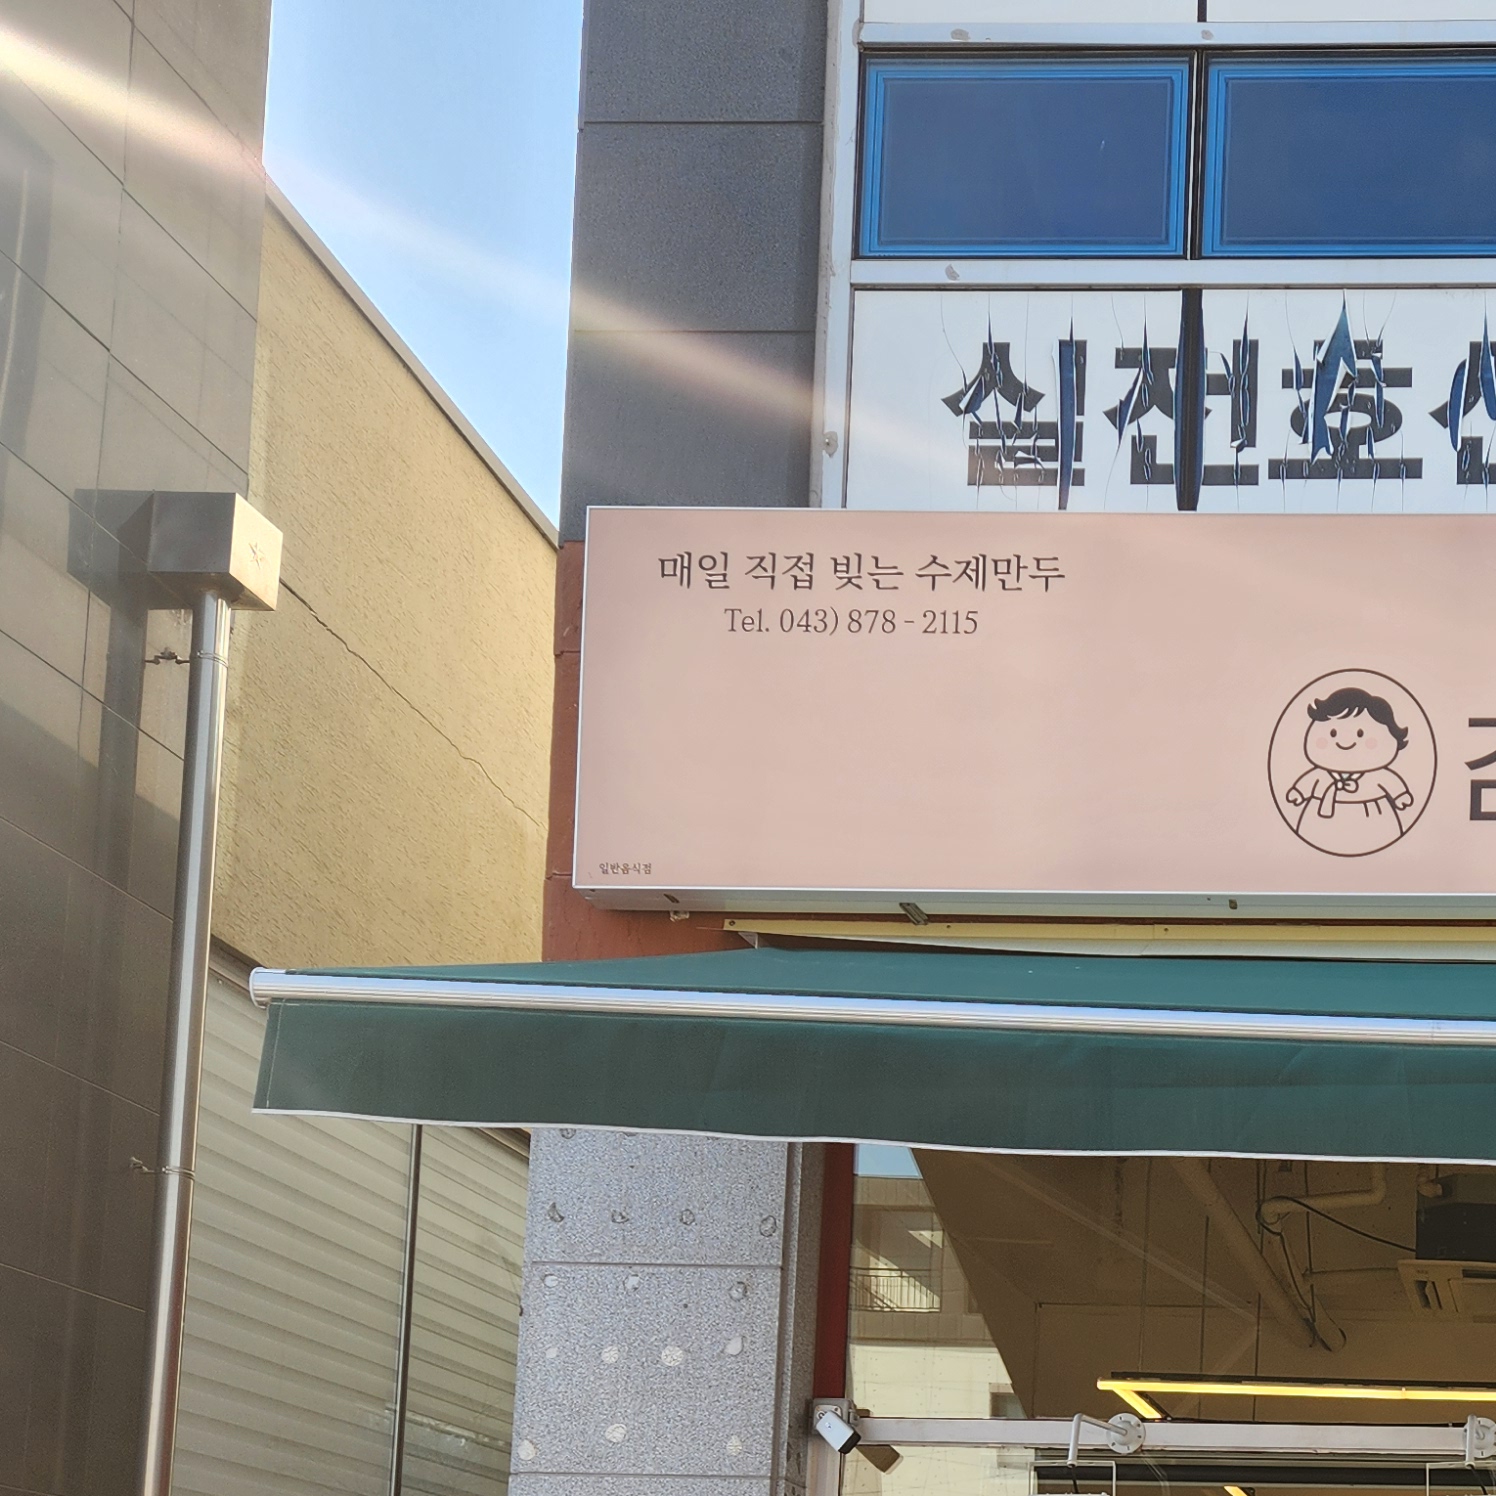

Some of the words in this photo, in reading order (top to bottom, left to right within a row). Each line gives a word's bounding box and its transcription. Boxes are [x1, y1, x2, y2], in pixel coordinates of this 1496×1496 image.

[658, 551, 731, 590] 매일
[744, 551, 816, 591] 직접
[831, 552, 904, 591] 빚는
[915, 553, 1066, 593] 수제만두
[724, 607, 770, 633] Tel.
[598, 861, 652, 875] 일반음식점
